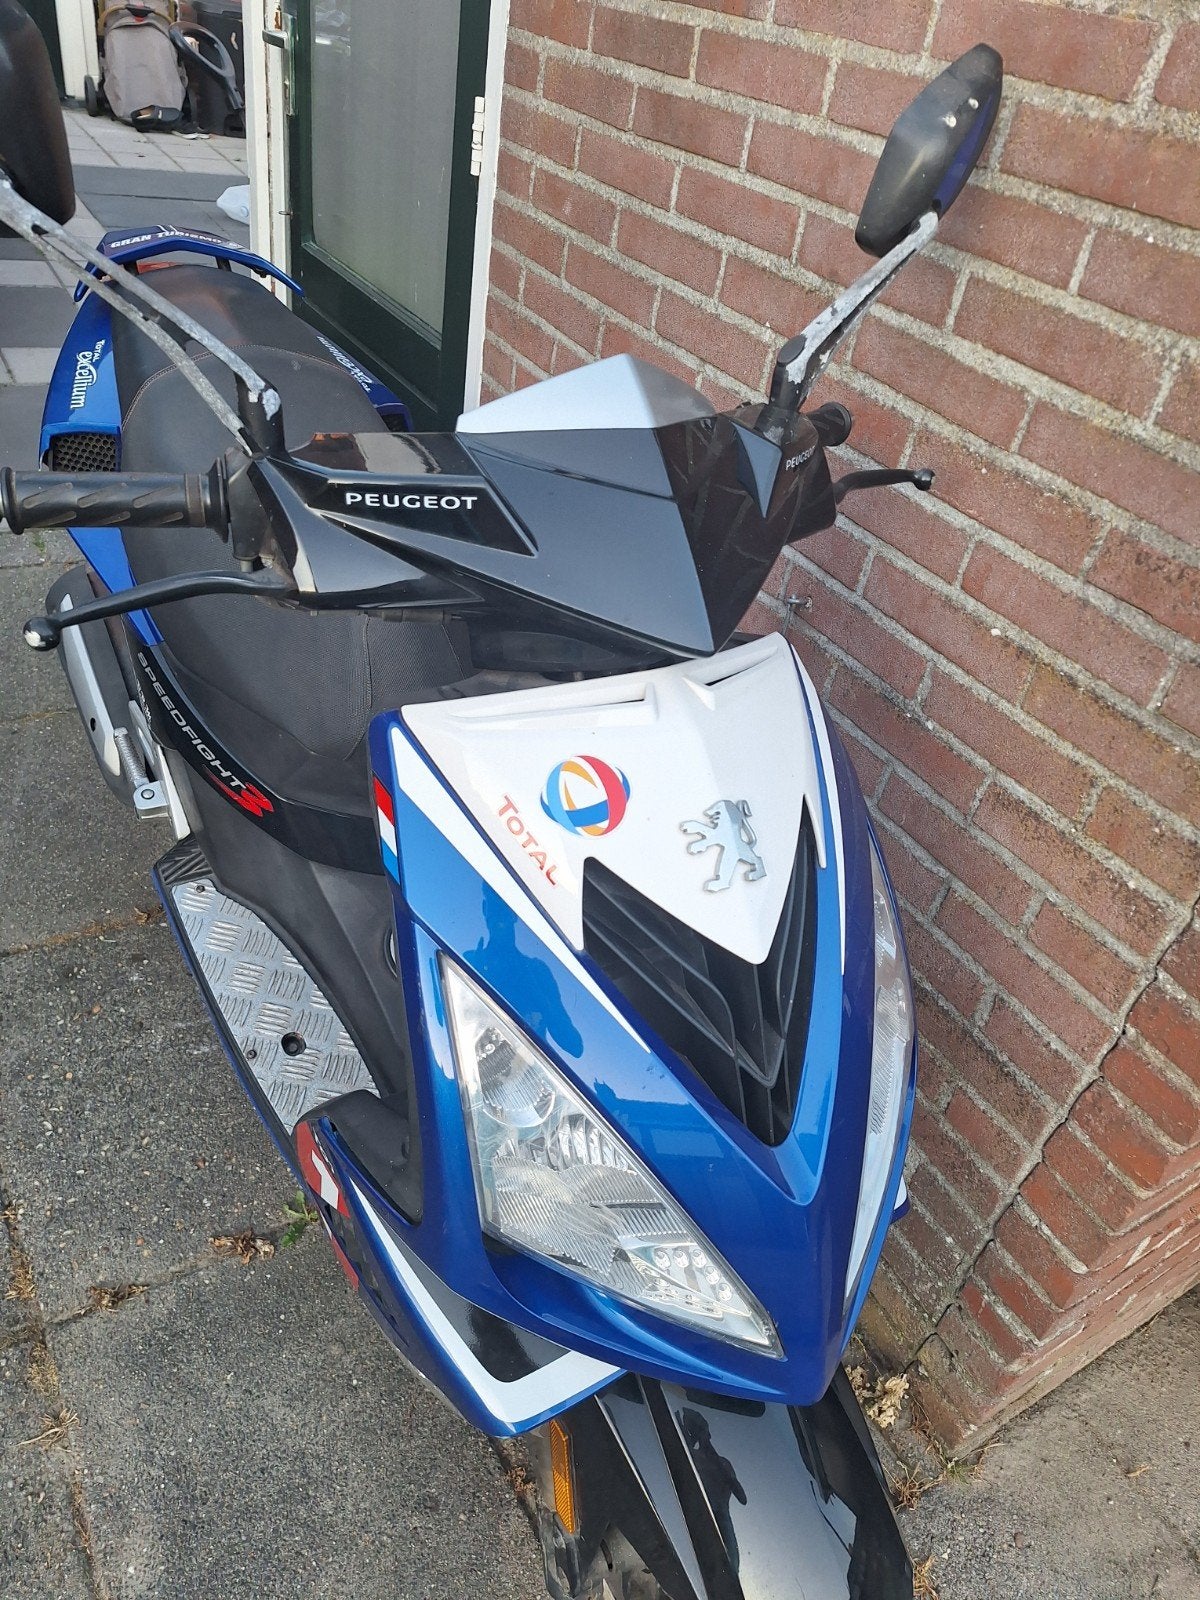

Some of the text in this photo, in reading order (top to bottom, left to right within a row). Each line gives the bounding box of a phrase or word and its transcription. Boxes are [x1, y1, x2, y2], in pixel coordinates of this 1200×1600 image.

[110, 234, 152, 249] GRAN
[157, 230, 222, 245] TURISMO
[92, 339, 106, 362] TOTAL
[69, 350, 97, 410] excellium
[345, 492, 478, 510] PEUGEOT
[498, 794, 558, 886] TOTAL
